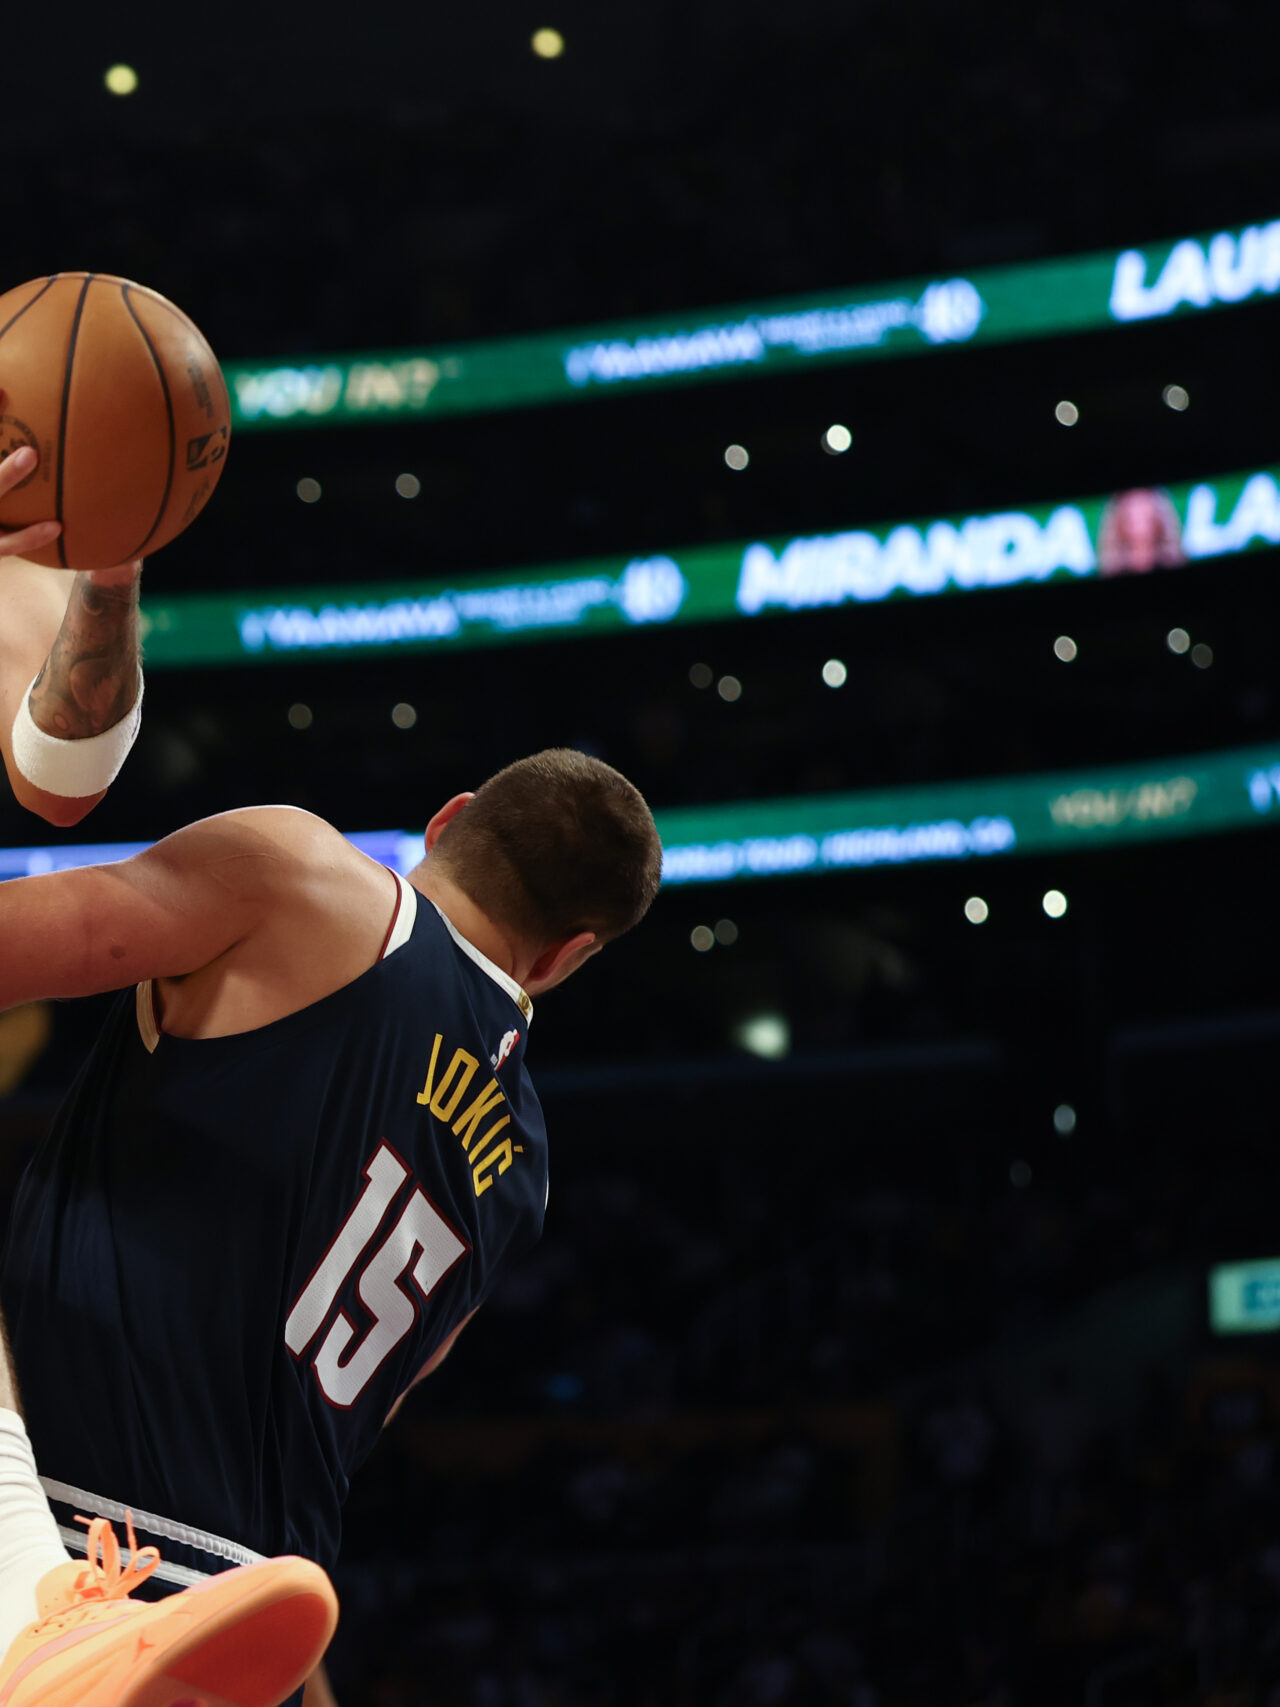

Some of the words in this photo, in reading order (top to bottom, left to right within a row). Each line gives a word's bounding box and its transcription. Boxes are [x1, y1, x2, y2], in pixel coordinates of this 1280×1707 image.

[736, 504, 1097, 616] MIRANDA
[416, 1032, 524, 1198] JOKIĆ
[284, 1136, 472, 1411] 15
